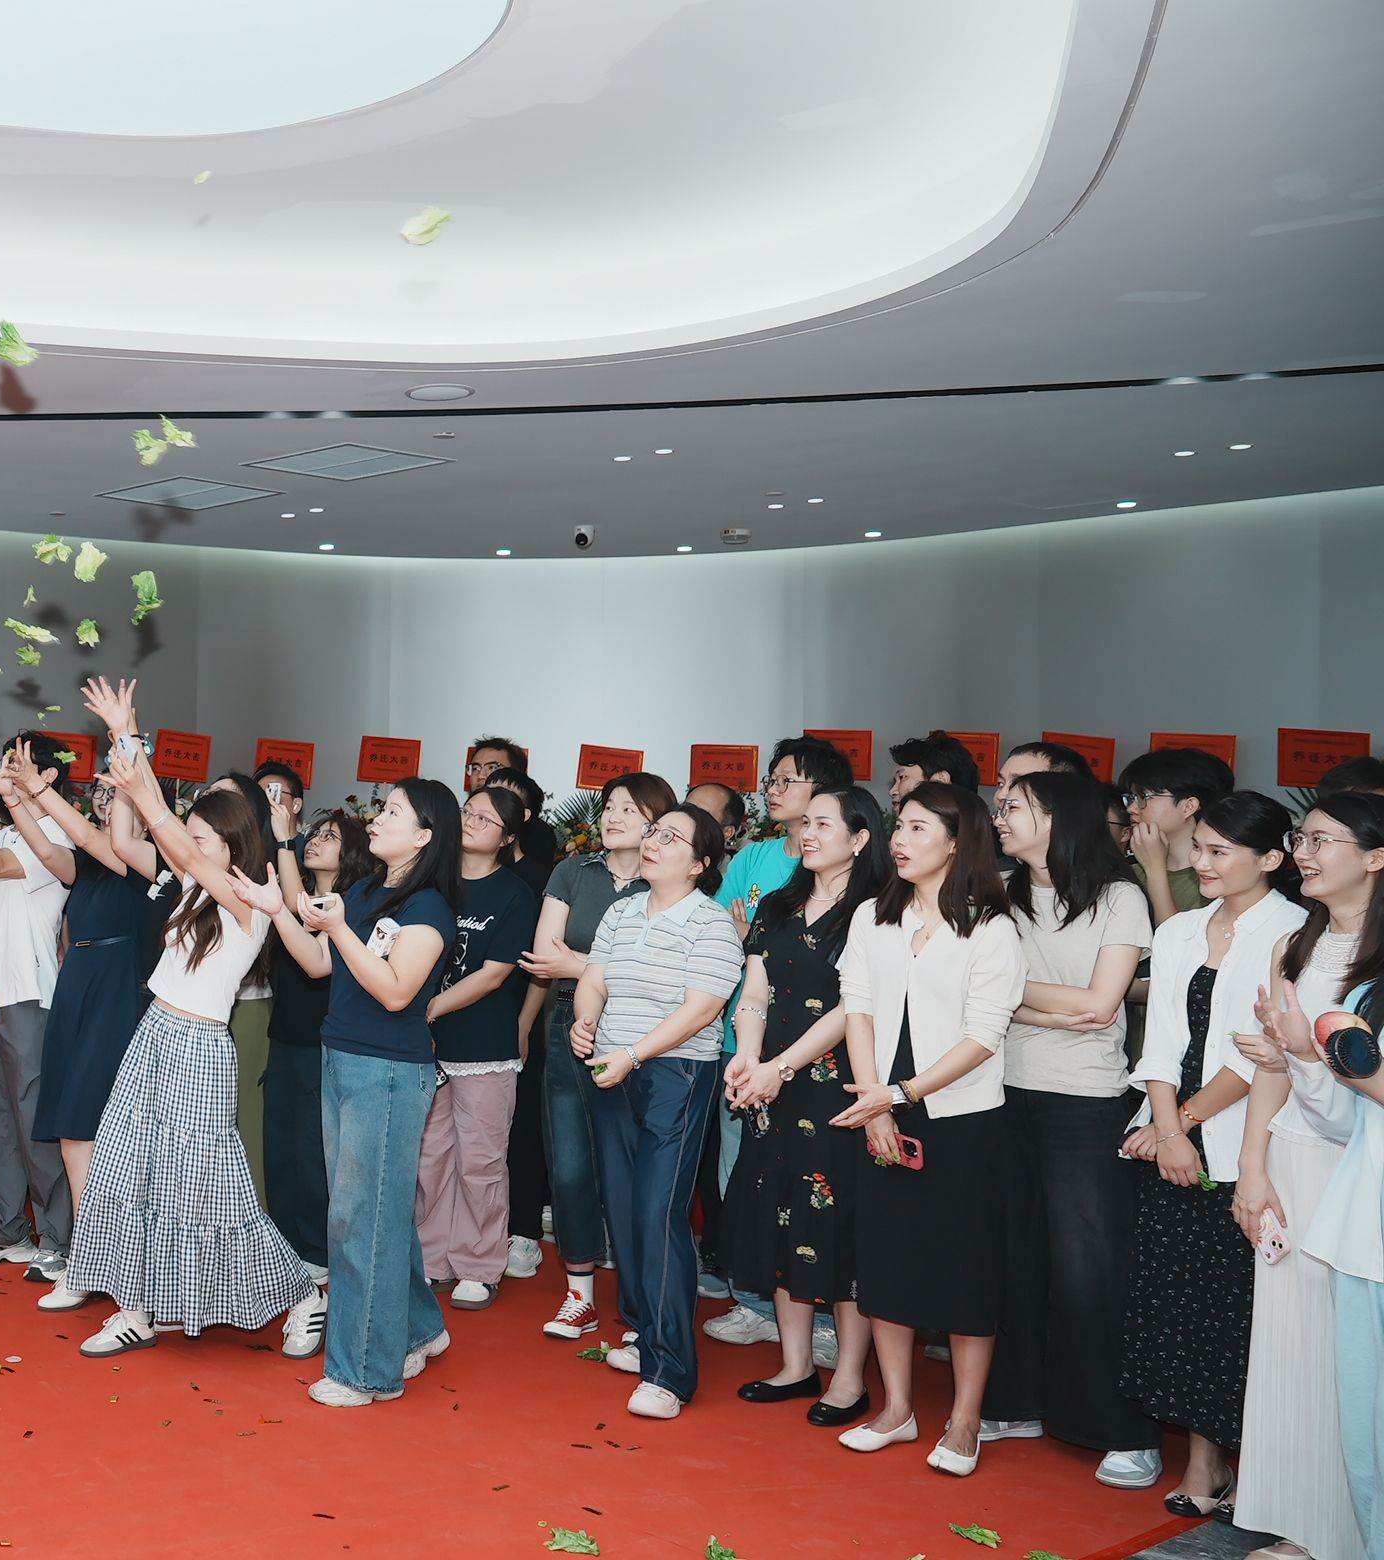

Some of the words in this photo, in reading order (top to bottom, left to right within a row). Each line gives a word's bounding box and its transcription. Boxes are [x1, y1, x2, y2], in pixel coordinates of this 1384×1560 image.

[164, 748, 201, 762] 乔迁大吉
[369, 753, 409, 765] 乔迁大吉
[589, 761, 631, 774] 乔迁大吉
[701, 760, 746, 771] 乔迁大吉
